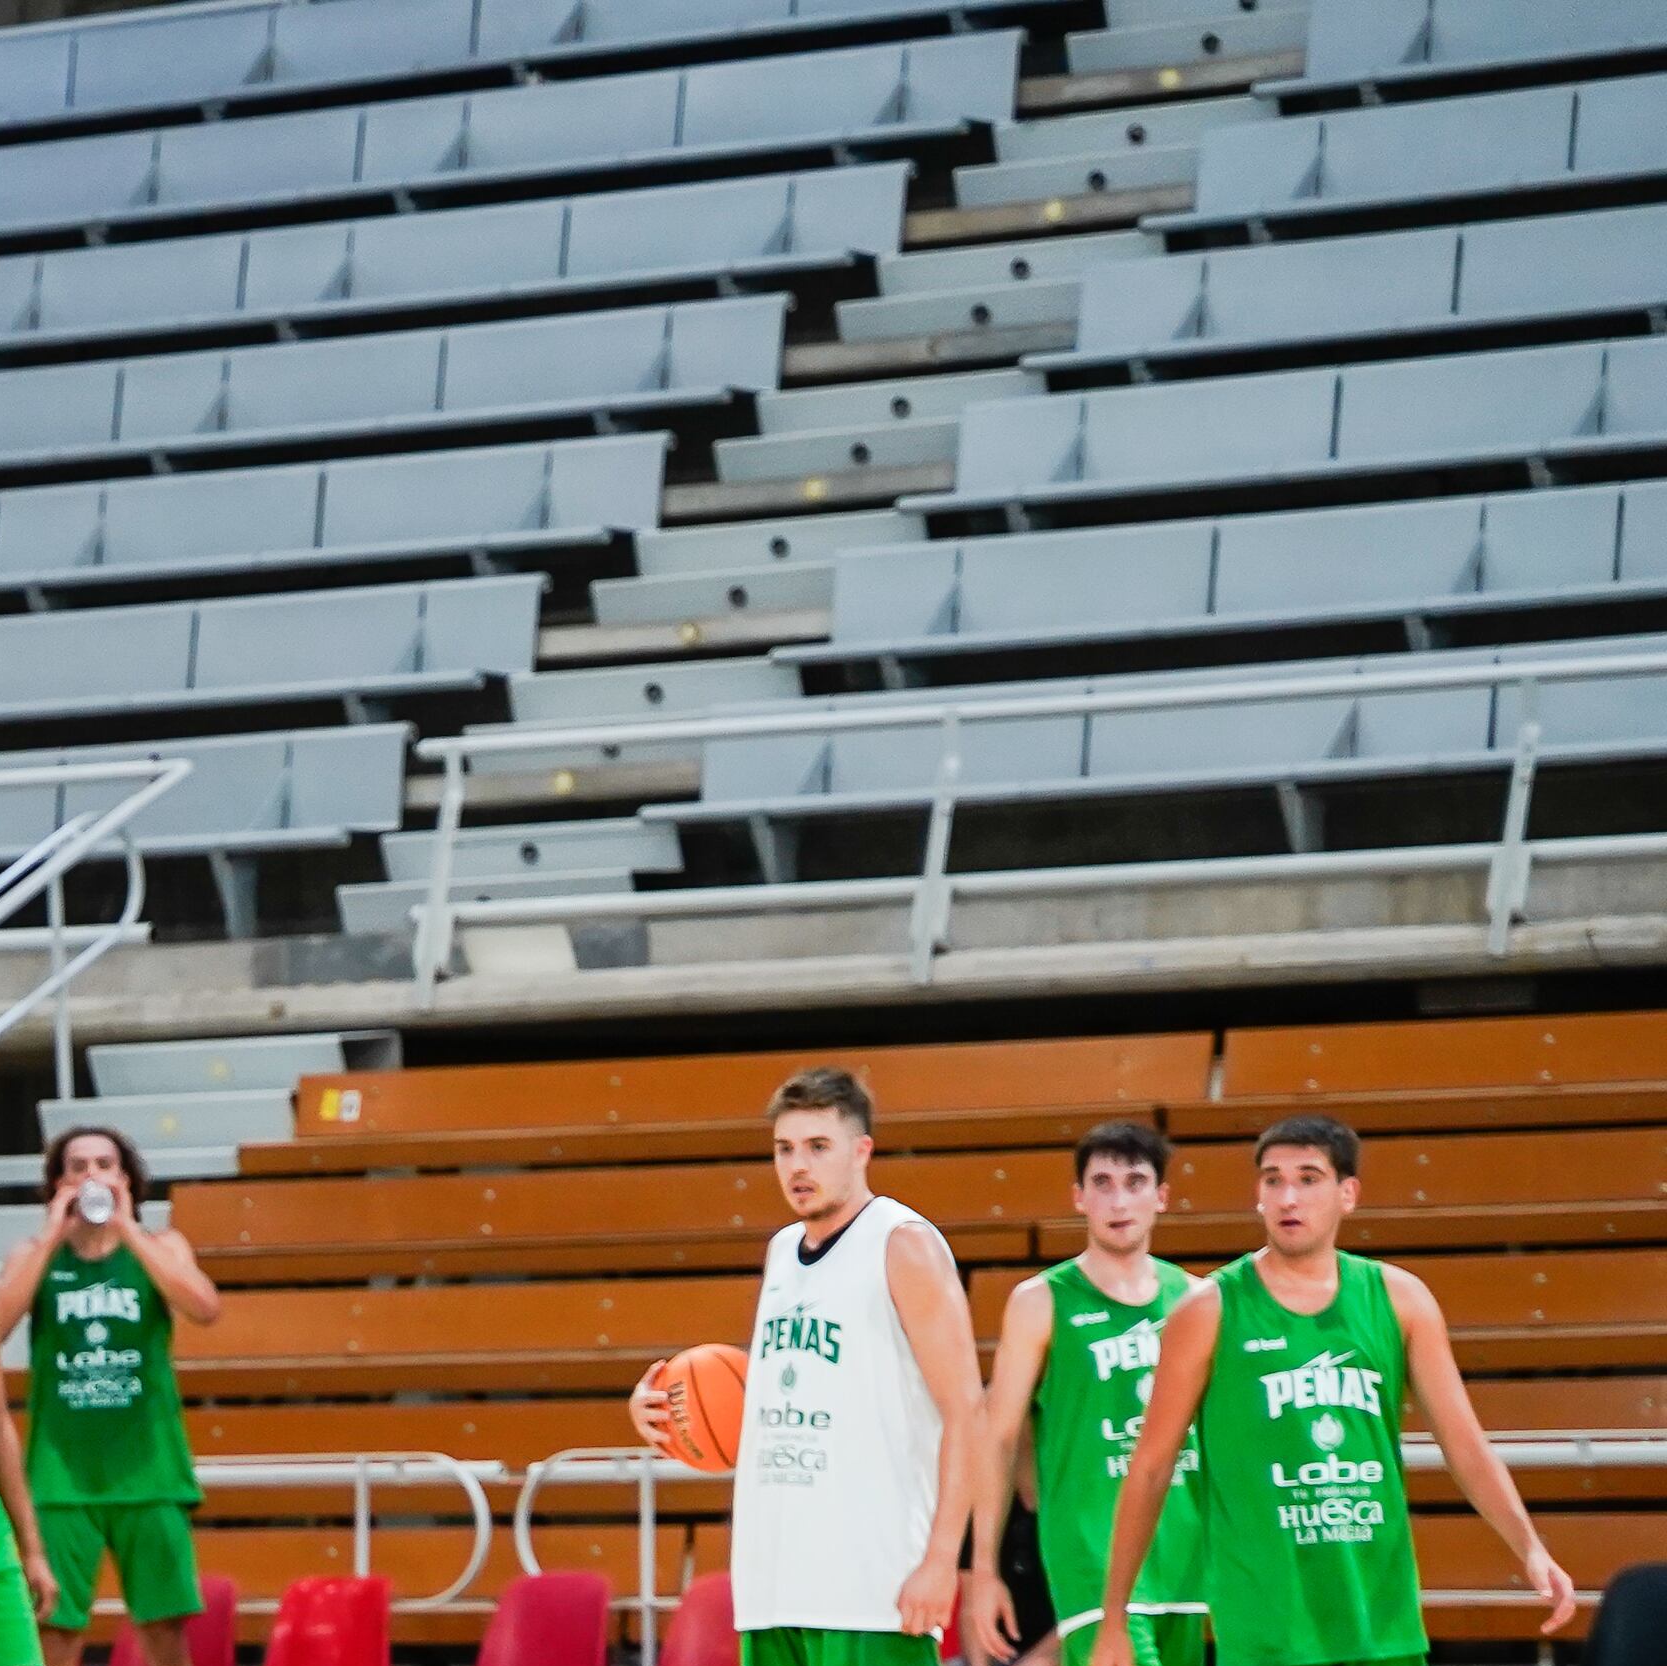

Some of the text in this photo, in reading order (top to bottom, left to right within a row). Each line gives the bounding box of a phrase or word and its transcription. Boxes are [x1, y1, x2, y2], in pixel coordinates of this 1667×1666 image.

[1088, 1318, 1162, 1381] PEÑ
[1259, 1349, 1383, 1419] PEÑAS
[1271, 1453, 1384, 1487] Lobe
